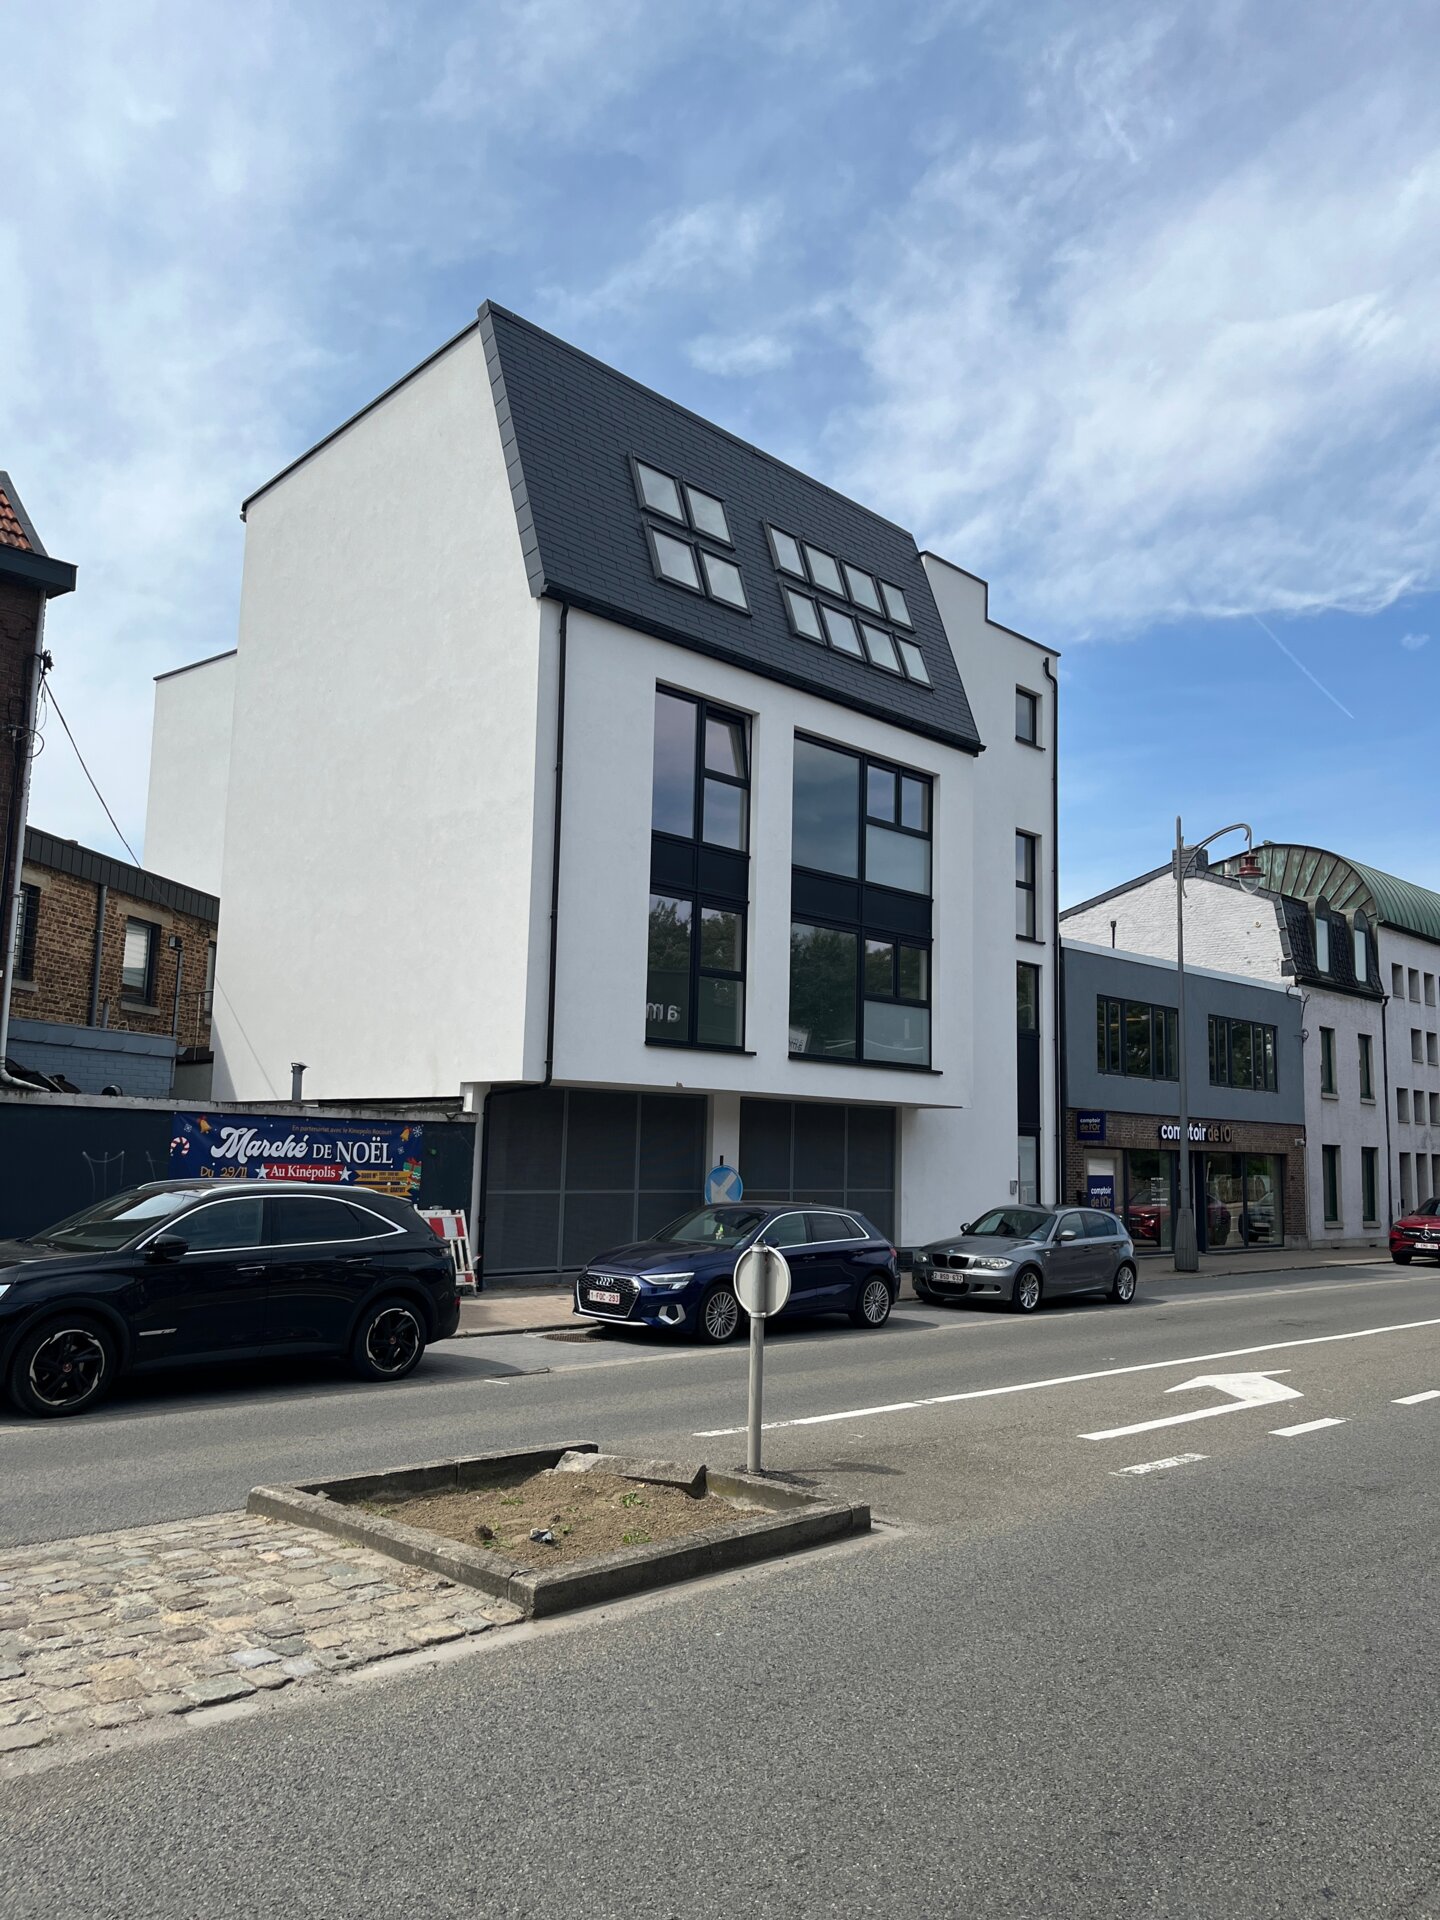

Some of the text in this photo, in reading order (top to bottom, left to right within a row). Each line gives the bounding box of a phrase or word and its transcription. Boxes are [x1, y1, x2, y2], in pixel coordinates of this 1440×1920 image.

[1161, 1123, 1207, 1141] comtoir
[1207, 1125, 1219, 1142] de
[211, 1126, 393, 1164] Marché DE NOËL
[220, 1166, 248, 1178] 29/11
[270, 1164, 336, 1181] Au Kinépolis
[1090, 1186, 1112, 1196] comptoir
[1090, 1196, 1100, 1208] de
